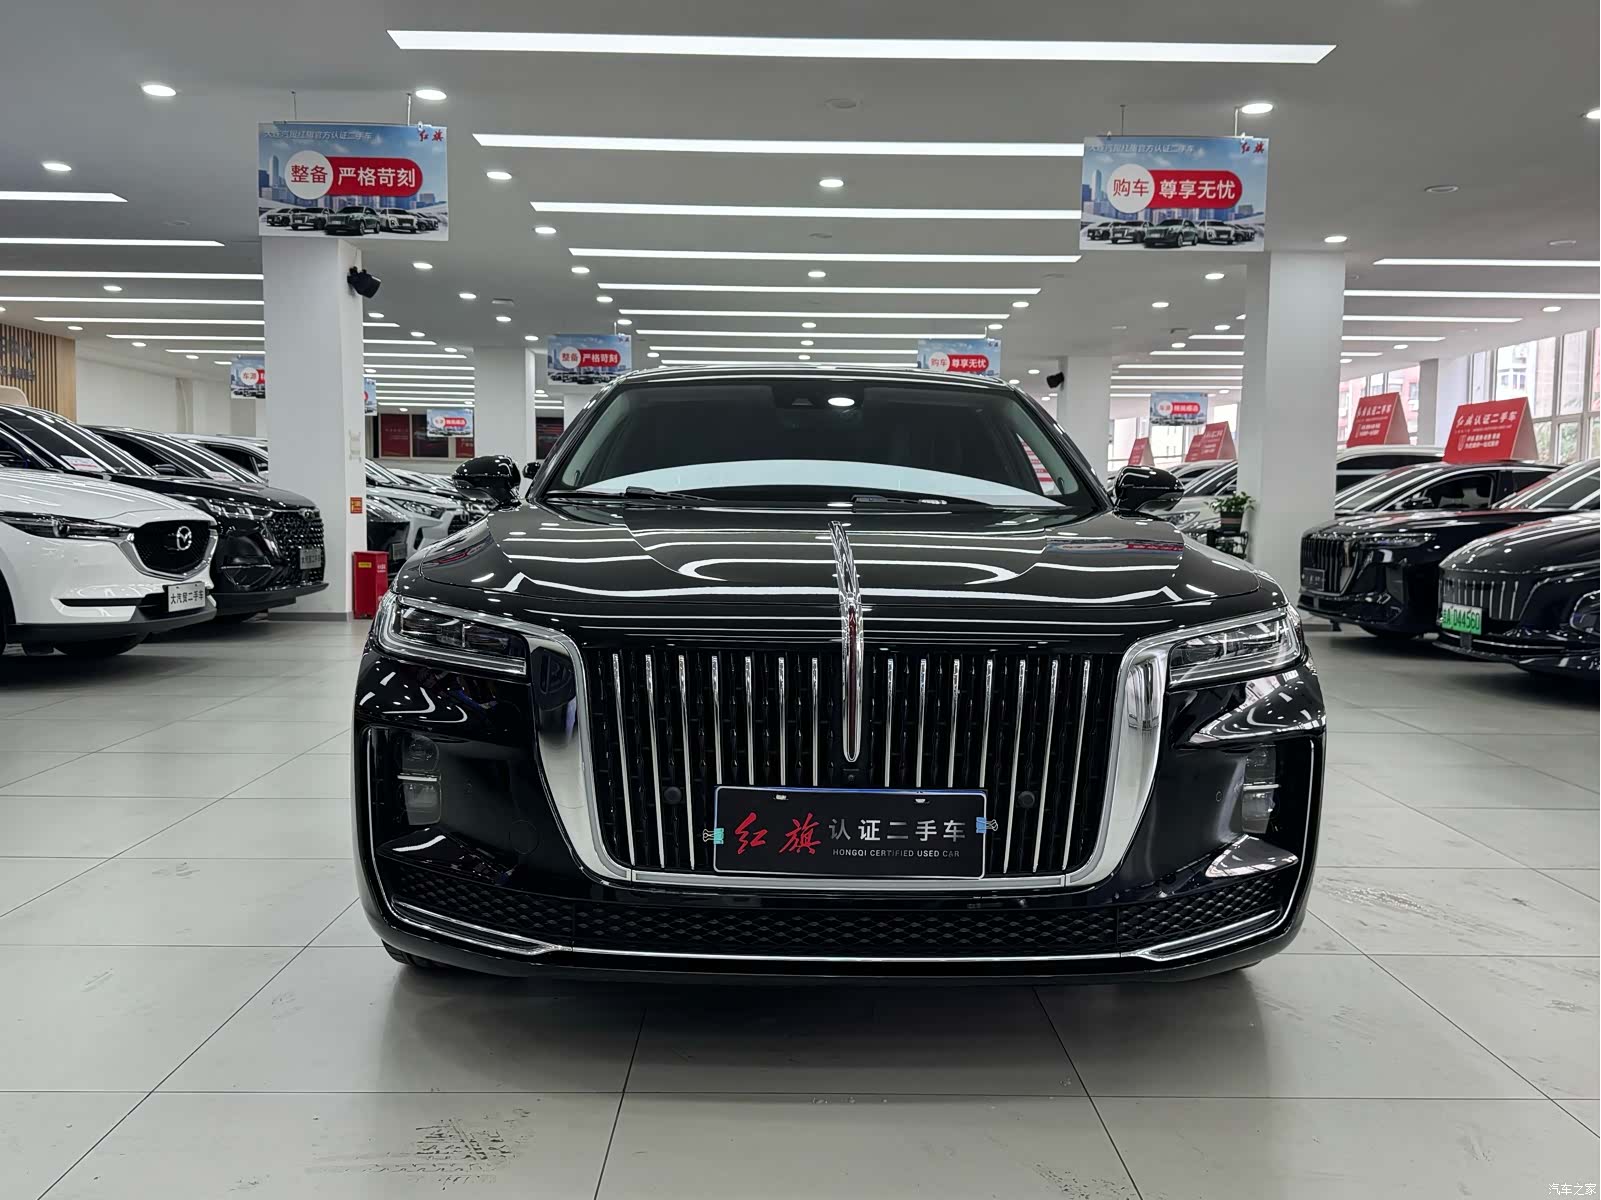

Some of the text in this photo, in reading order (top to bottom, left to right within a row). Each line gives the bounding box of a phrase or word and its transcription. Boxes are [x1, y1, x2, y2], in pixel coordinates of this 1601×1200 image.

[418, 129, 443, 142] 红旗
[1240, 141, 1265, 154] 红旗
[290, 164, 416, 188] 整备 严格苛刻
[1112, 177, 1236, 200] 购车 尊享无忧
[582, 353, 618, 364] 严格苛刻
[951, 358, 987, 368] 尊享无忧
[170, 589, 204, 605] 大汽贸二手车
[734, 812, 967, 855] 红旗 认证二手车
[832, 848, 960, 859] HONGQI CERTIFIED USED CAR
